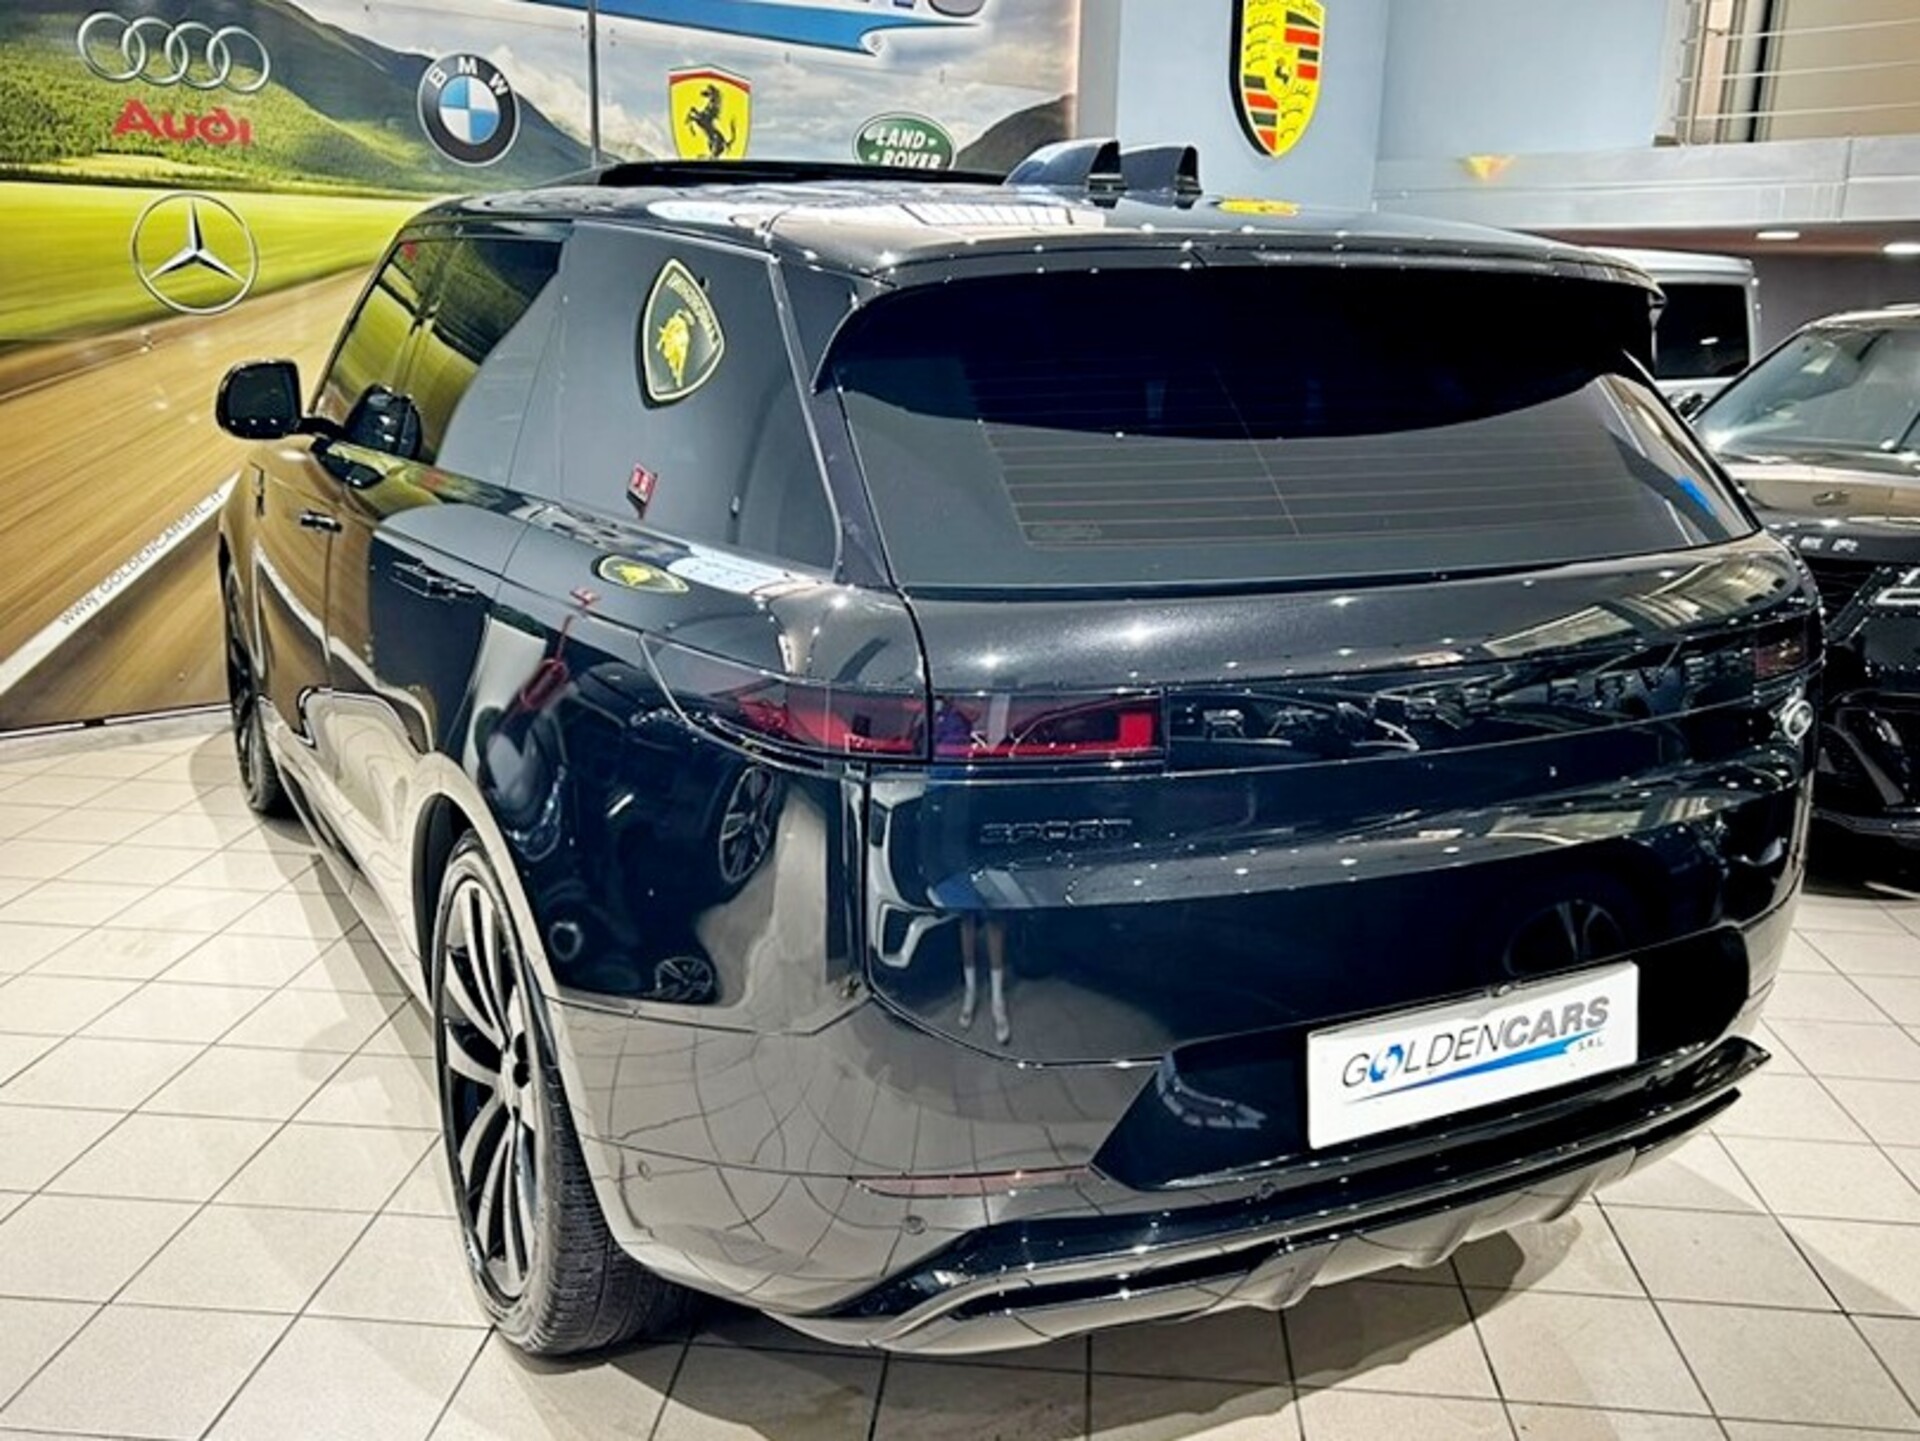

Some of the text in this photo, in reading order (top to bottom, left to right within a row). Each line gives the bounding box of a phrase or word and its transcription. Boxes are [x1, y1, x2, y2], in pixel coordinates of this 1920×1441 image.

[427, 56, 509, 96] BMW
[112, 99, 252, 146] Audi
[875, 127, 926, 150] LAND
[881, 149, 941, 169] ROVER
[980, 818, 1132, 844] SPORT
[1341, 996, 1609, 1087] GOLDENCARS
